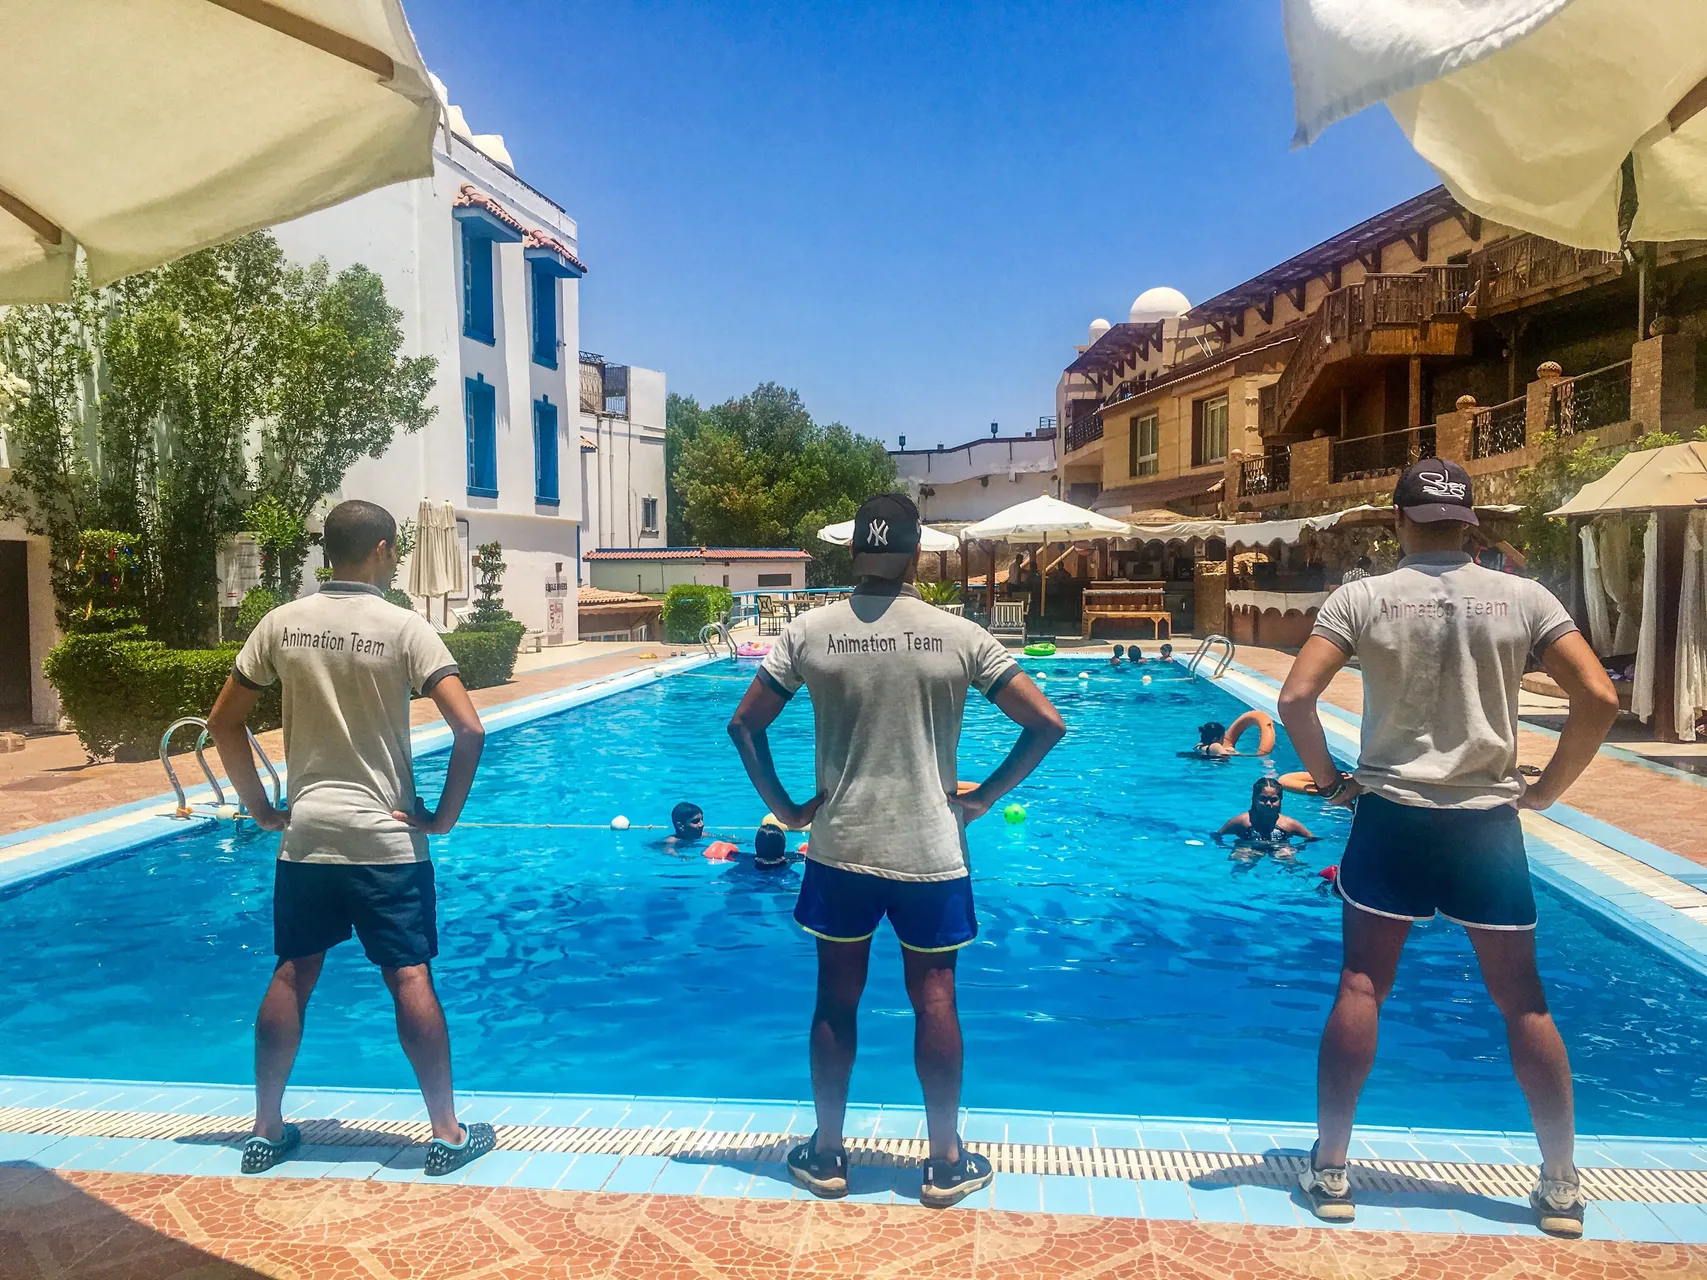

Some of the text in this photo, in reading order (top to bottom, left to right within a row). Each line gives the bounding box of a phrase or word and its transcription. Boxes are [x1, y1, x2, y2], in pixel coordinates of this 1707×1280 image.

[867, 518, 889, 546] NY
[1380, 596, 1508, 620] Animation Team
[281, 626, 385, 656] Animation Team
[827, 631, 943, 654] Animation Team
